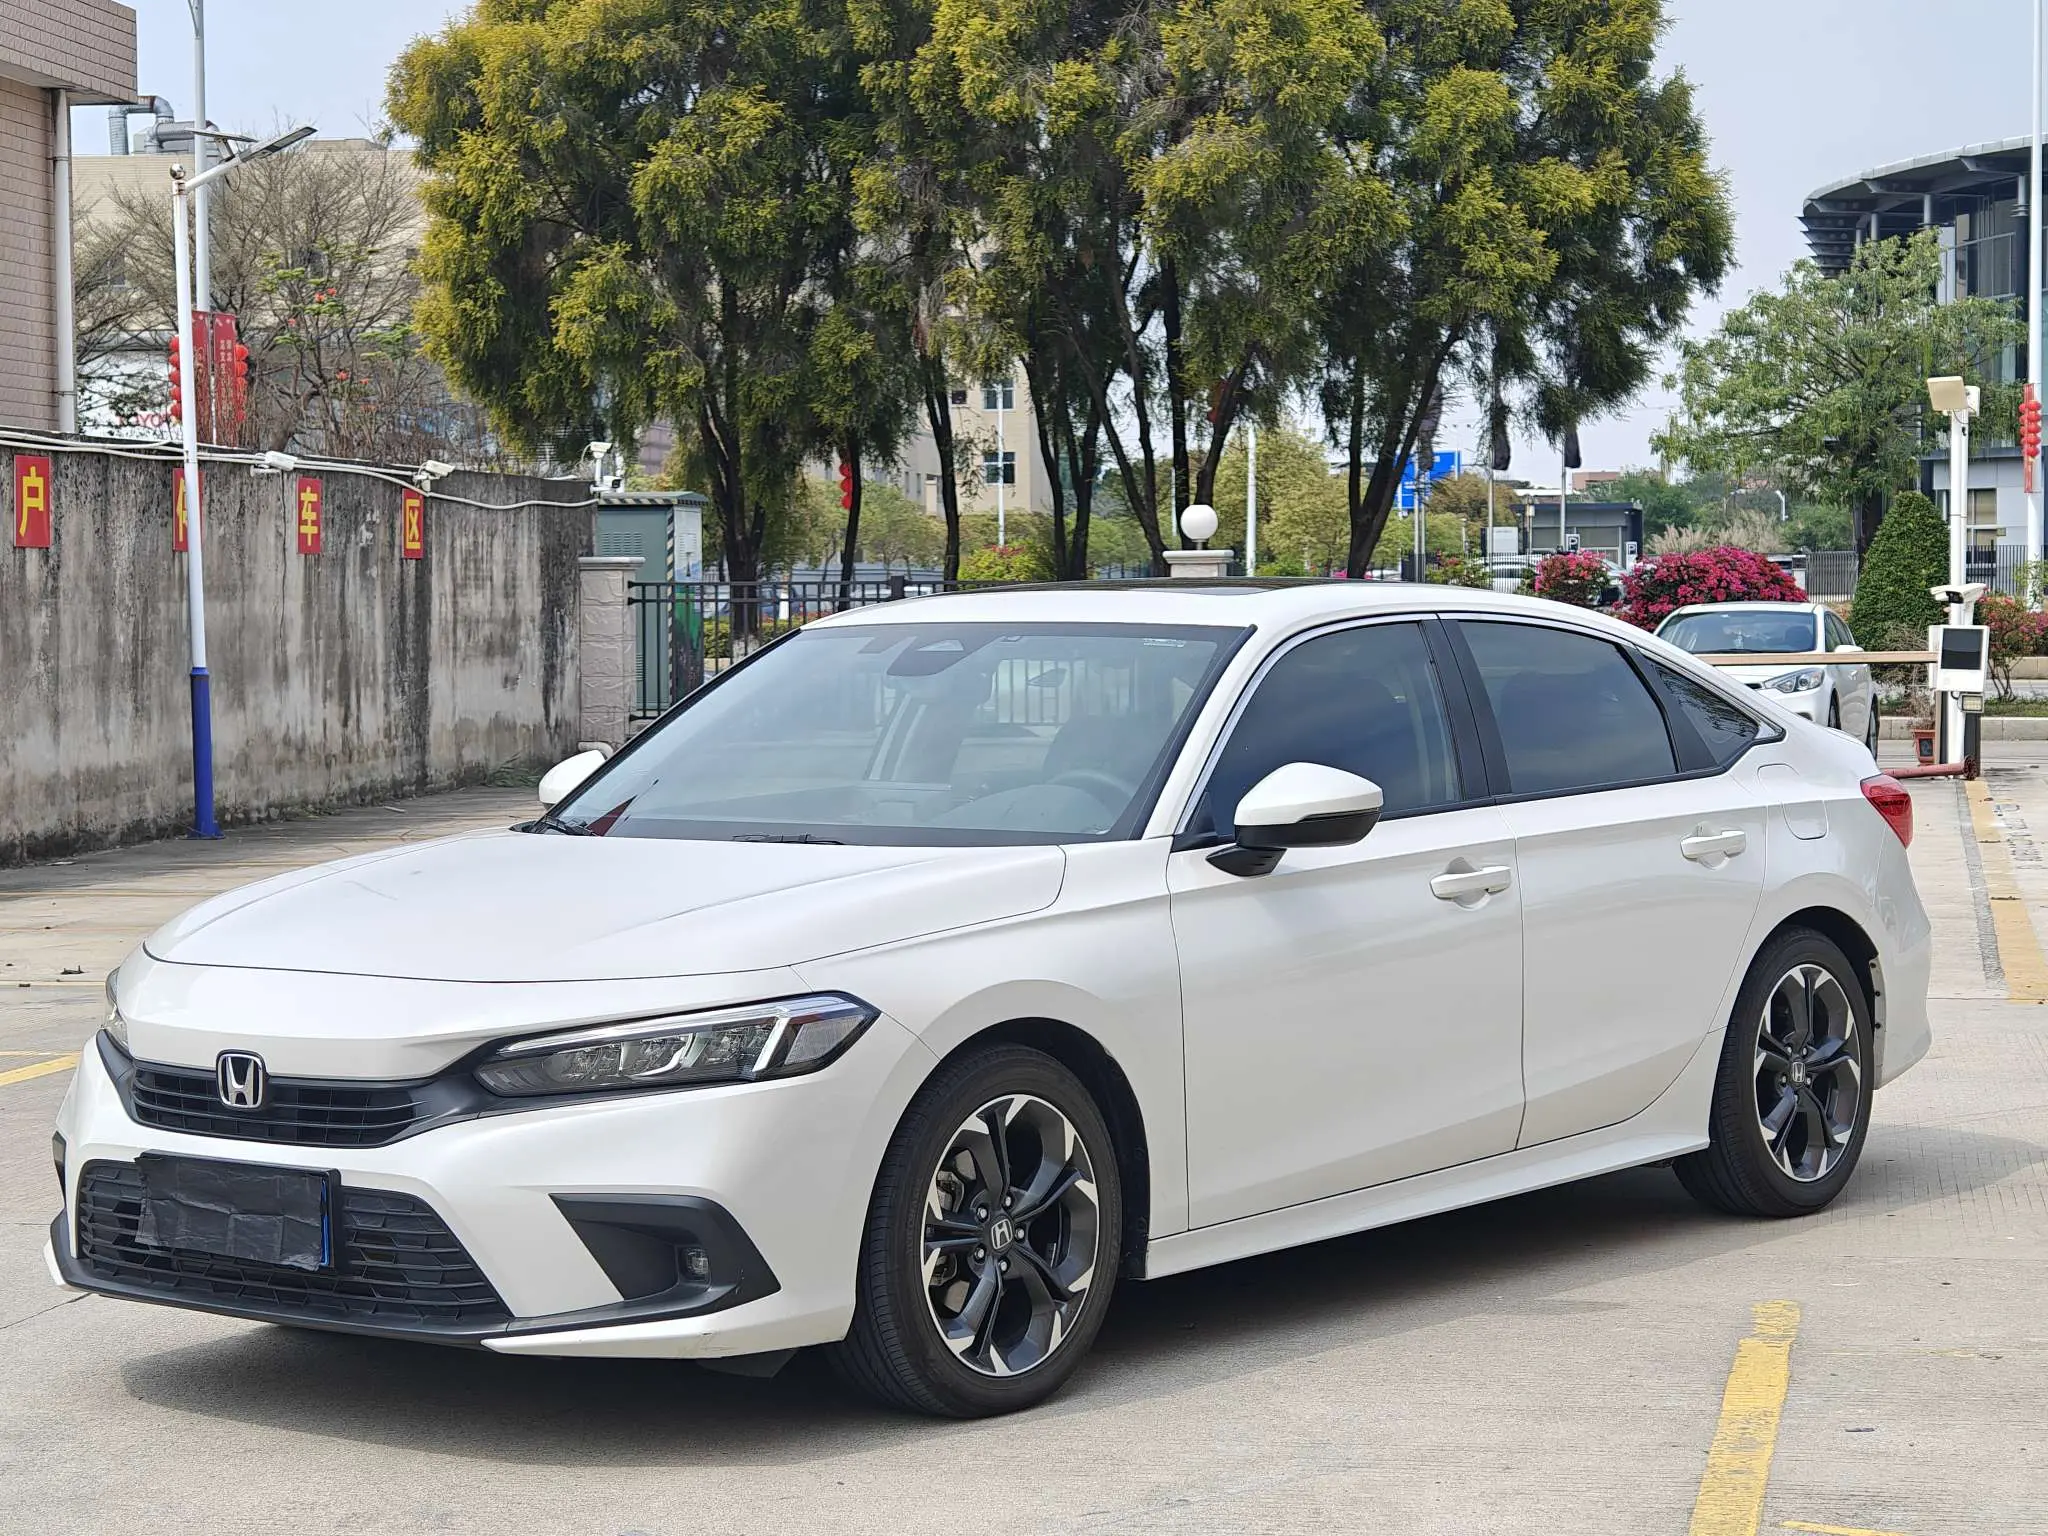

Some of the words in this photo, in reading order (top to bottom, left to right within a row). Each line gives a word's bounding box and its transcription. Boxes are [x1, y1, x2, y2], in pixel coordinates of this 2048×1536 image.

[19, 466, 44, 537] 户
[300, 486, 318, 546] 车
[406, 499, 421, 549] 区
[1568, 537, 1578, 549] P
[1628, 544, 1636, 555] P
